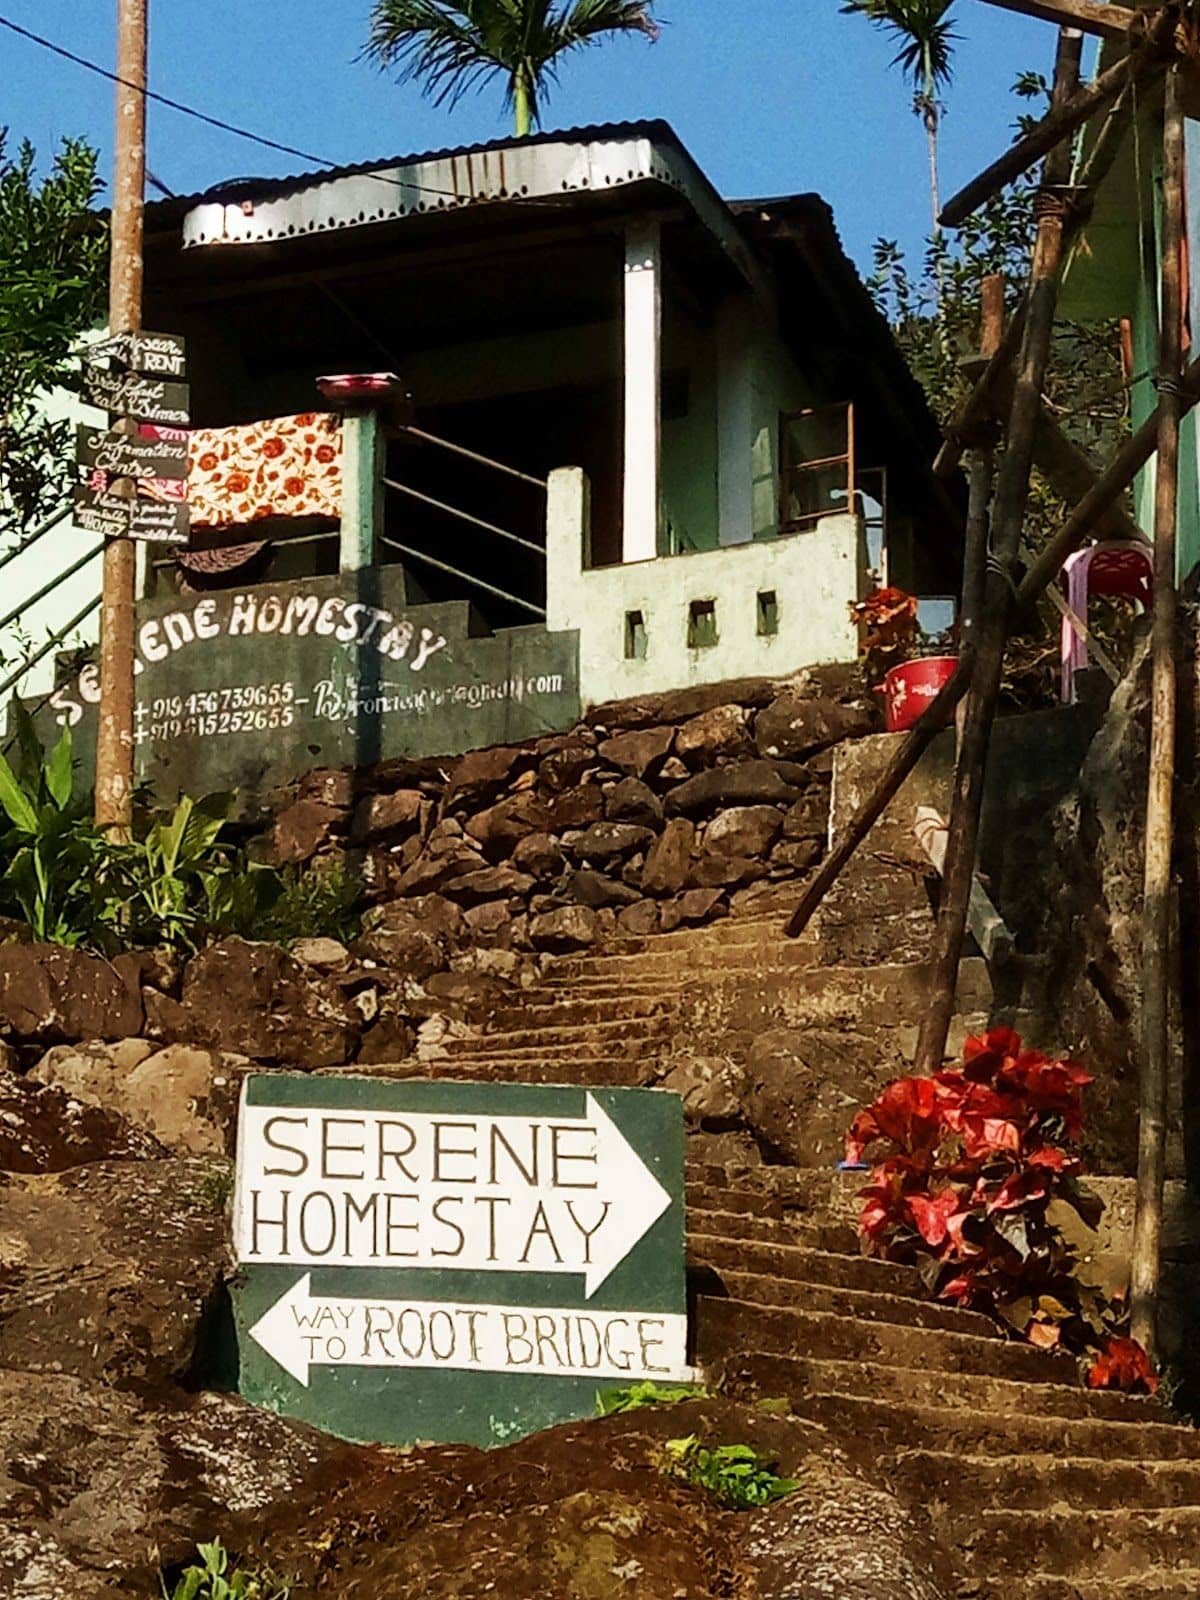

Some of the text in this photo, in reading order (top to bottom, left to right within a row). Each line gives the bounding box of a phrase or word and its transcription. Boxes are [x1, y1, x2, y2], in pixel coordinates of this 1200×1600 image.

[143, 352, 185, 375] RENT
[88, 430, 186, 460] Information
[95, 451, 156, 477] Centre
[49, 593, 447, 727] SEENE HOMESTAY
[262, 1116, 598, 1190] SERENE
[248, 1190, 612, 1265] HOMESTAY
[291, 1304, 671, 1374] WAY TO ROOT BRIDGE
